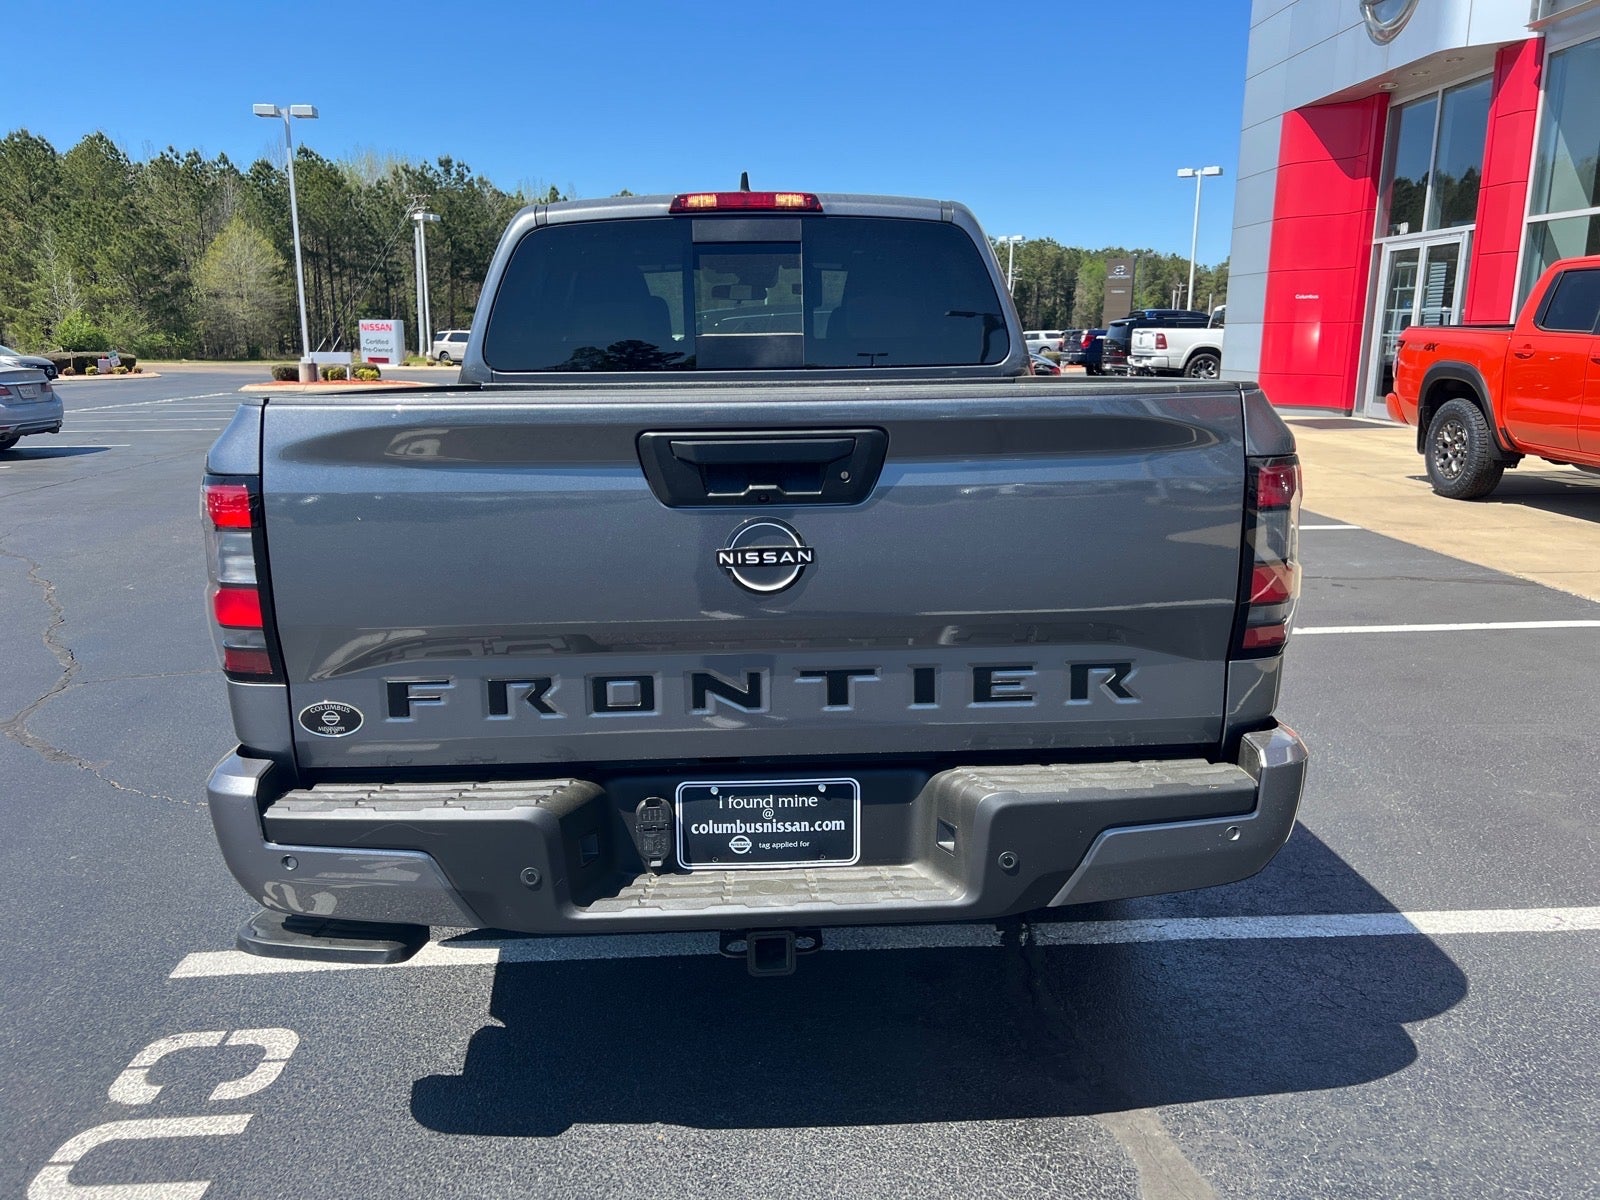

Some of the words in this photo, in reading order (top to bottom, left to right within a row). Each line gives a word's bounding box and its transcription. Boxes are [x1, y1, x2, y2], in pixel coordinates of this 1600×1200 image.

[361, 323, 392, 331] NISSAN
[719, 551, 812, 564] NISSAN
[384, 661, 1140, 722] FRONTIER
[310, 704, 350, 713] COLUMBUS
[719, 796, 723, 809] I
[728, 795, 773, 809] found
[778, 794, 818, 808] mine
[691, 819, 845, 834] columbusnissan.com
[758, 841, 771, 850] tag
[772, 841, 797, 849] applied
[799, 840, 810, 848] for
